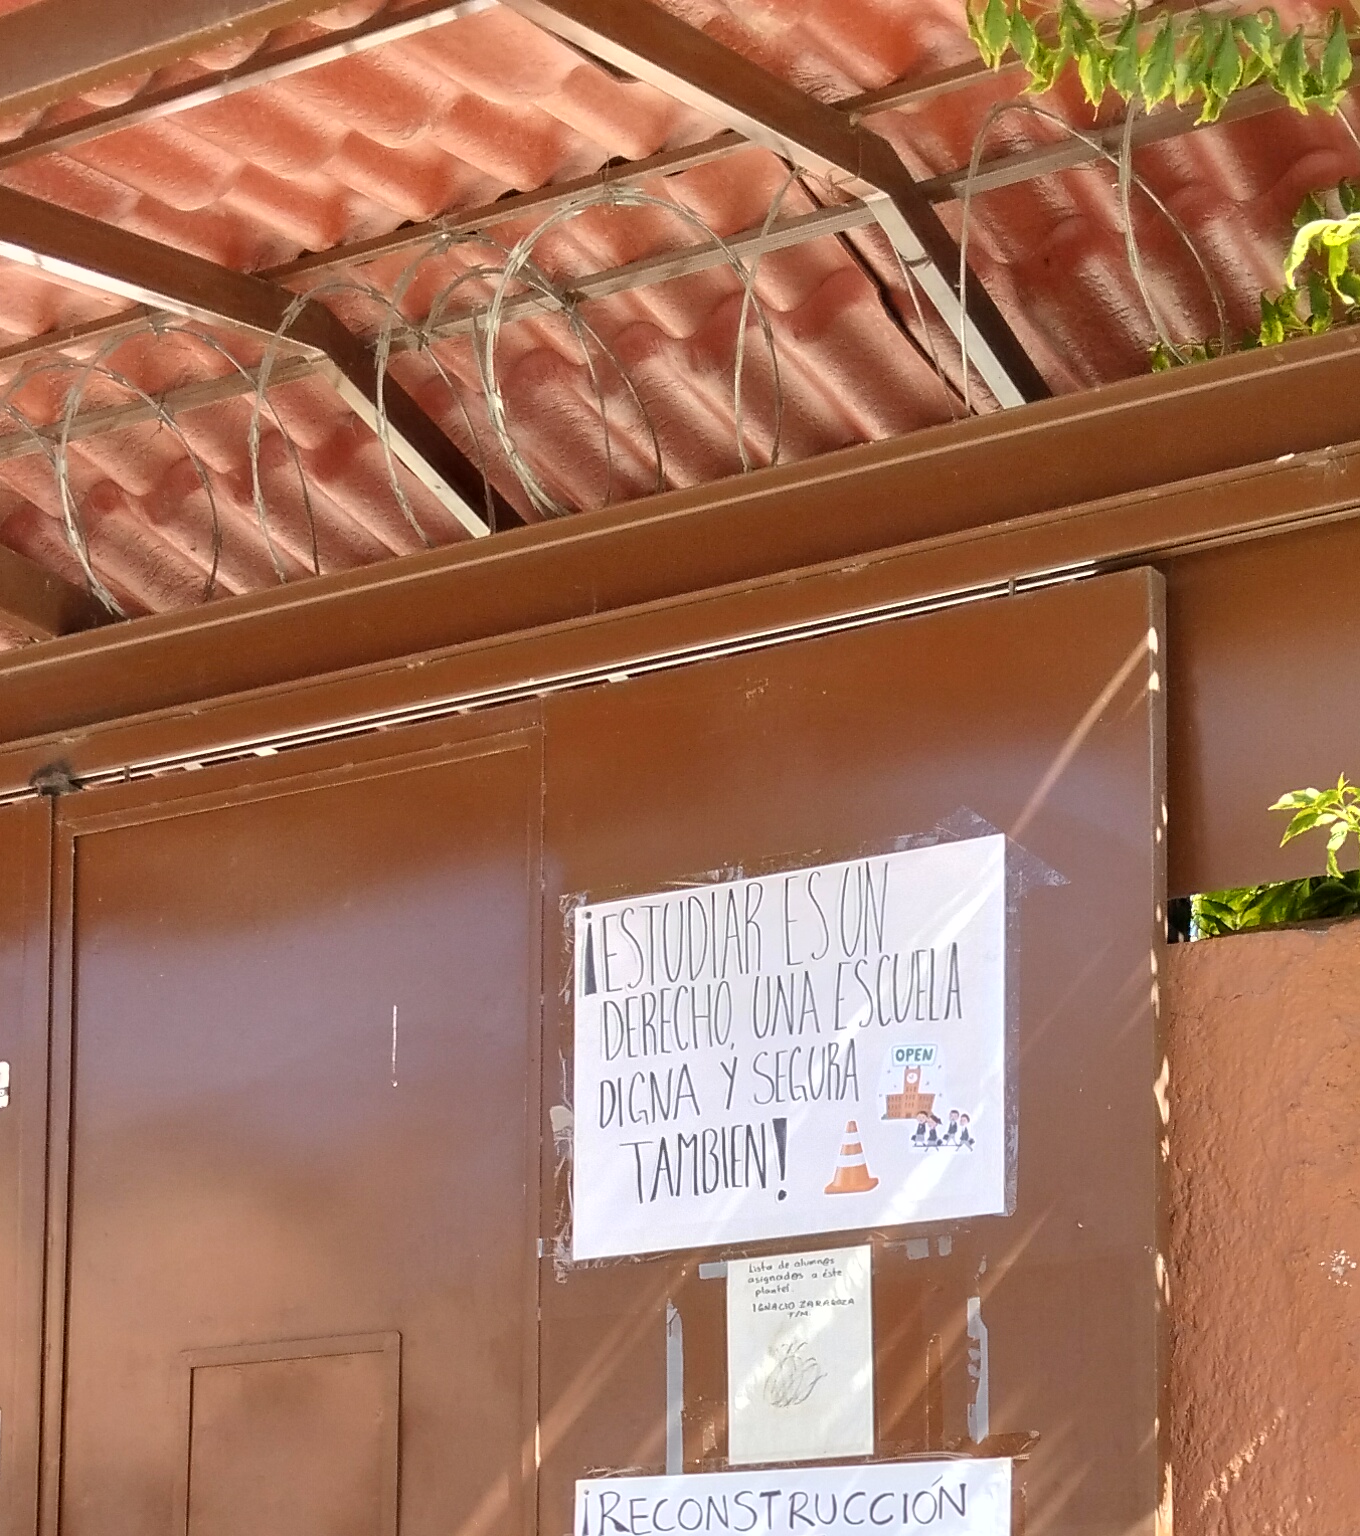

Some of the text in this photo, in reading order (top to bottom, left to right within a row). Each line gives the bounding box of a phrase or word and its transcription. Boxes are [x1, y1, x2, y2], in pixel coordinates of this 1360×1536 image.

[583, 861, 888, 996] ¡ESTUDIAR ES UN
[602, 942, 963, 1061] DERECHO, UNA ESCUELA
[599, 1038, 860, 1129] DIGNA Y SEGURA
[895, 1047, 934, 1063] OPEN
[619, 1118, 788, 1204] TAMBIEN!
[749, 1261, 772, 1273] Lista
[778, 1260, 789, 1269] de
[752, 1298, 854, 1312] IGNACIO ZARAGOZA
